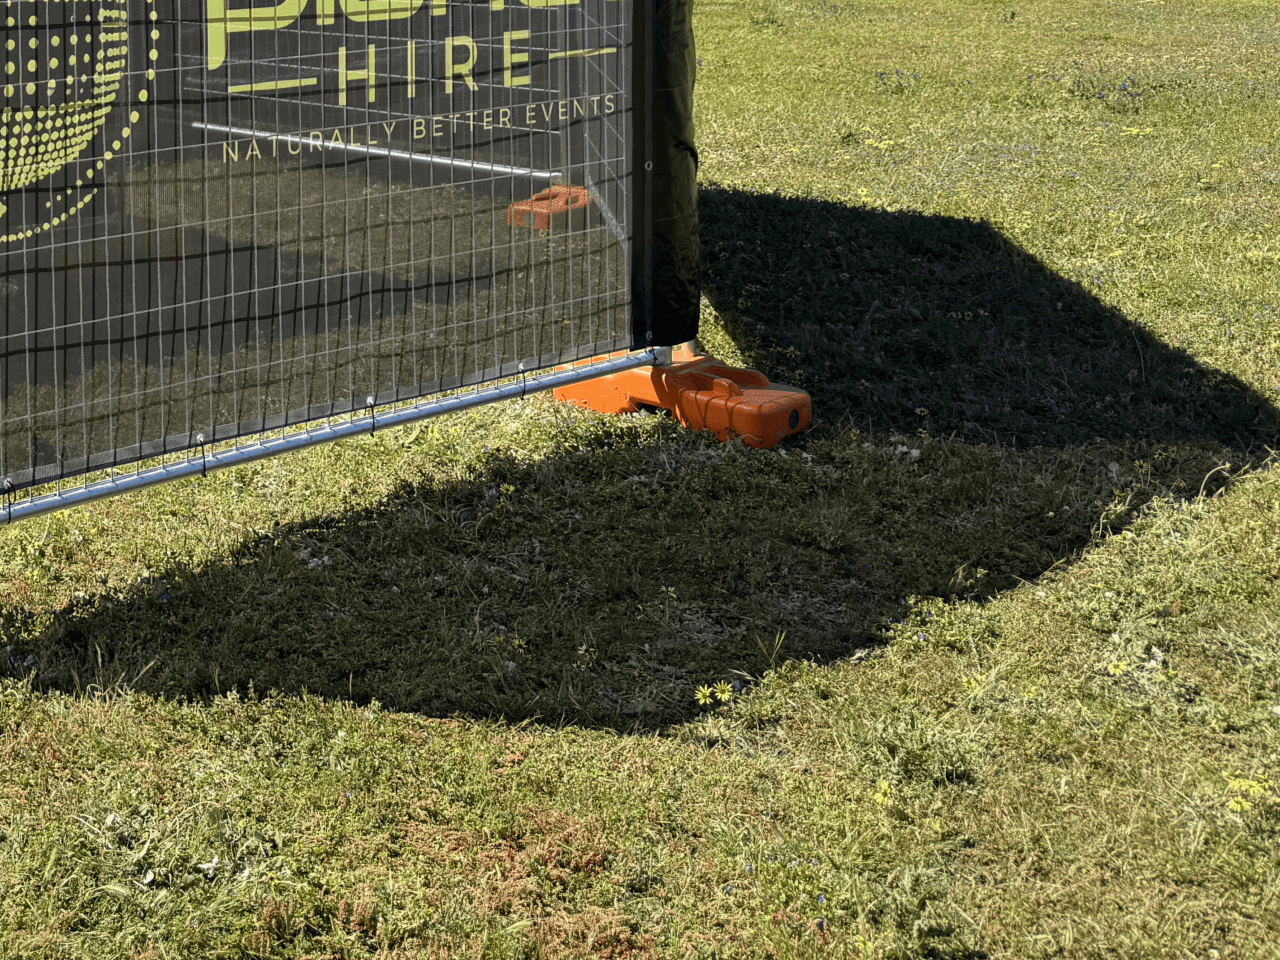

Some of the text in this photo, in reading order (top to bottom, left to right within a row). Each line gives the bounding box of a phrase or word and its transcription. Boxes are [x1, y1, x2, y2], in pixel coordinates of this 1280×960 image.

[337, 30, 530, 106] HIRE
[222, 94, 616, 164] NATURALLY BETTER EVENTS
